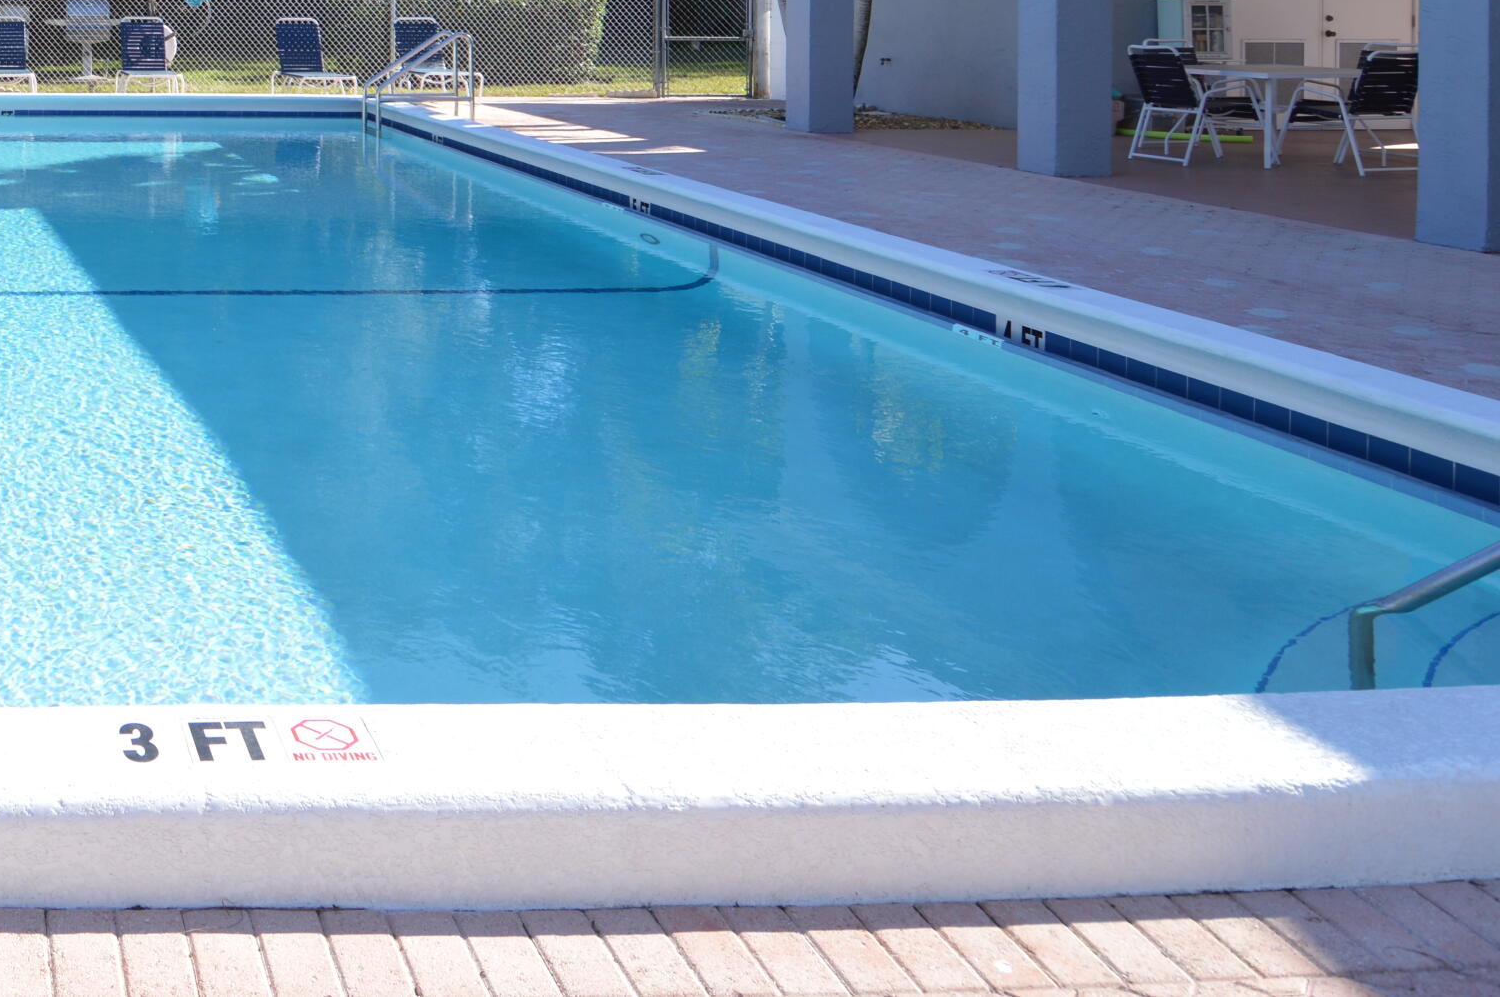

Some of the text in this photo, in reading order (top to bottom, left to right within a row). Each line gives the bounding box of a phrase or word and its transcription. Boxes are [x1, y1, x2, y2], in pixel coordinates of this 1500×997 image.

[1021, 325, 1043, 348] FT
[118, 720, 267, 763] 3 FT
[292, 752, 378, 761] NO DIVING
